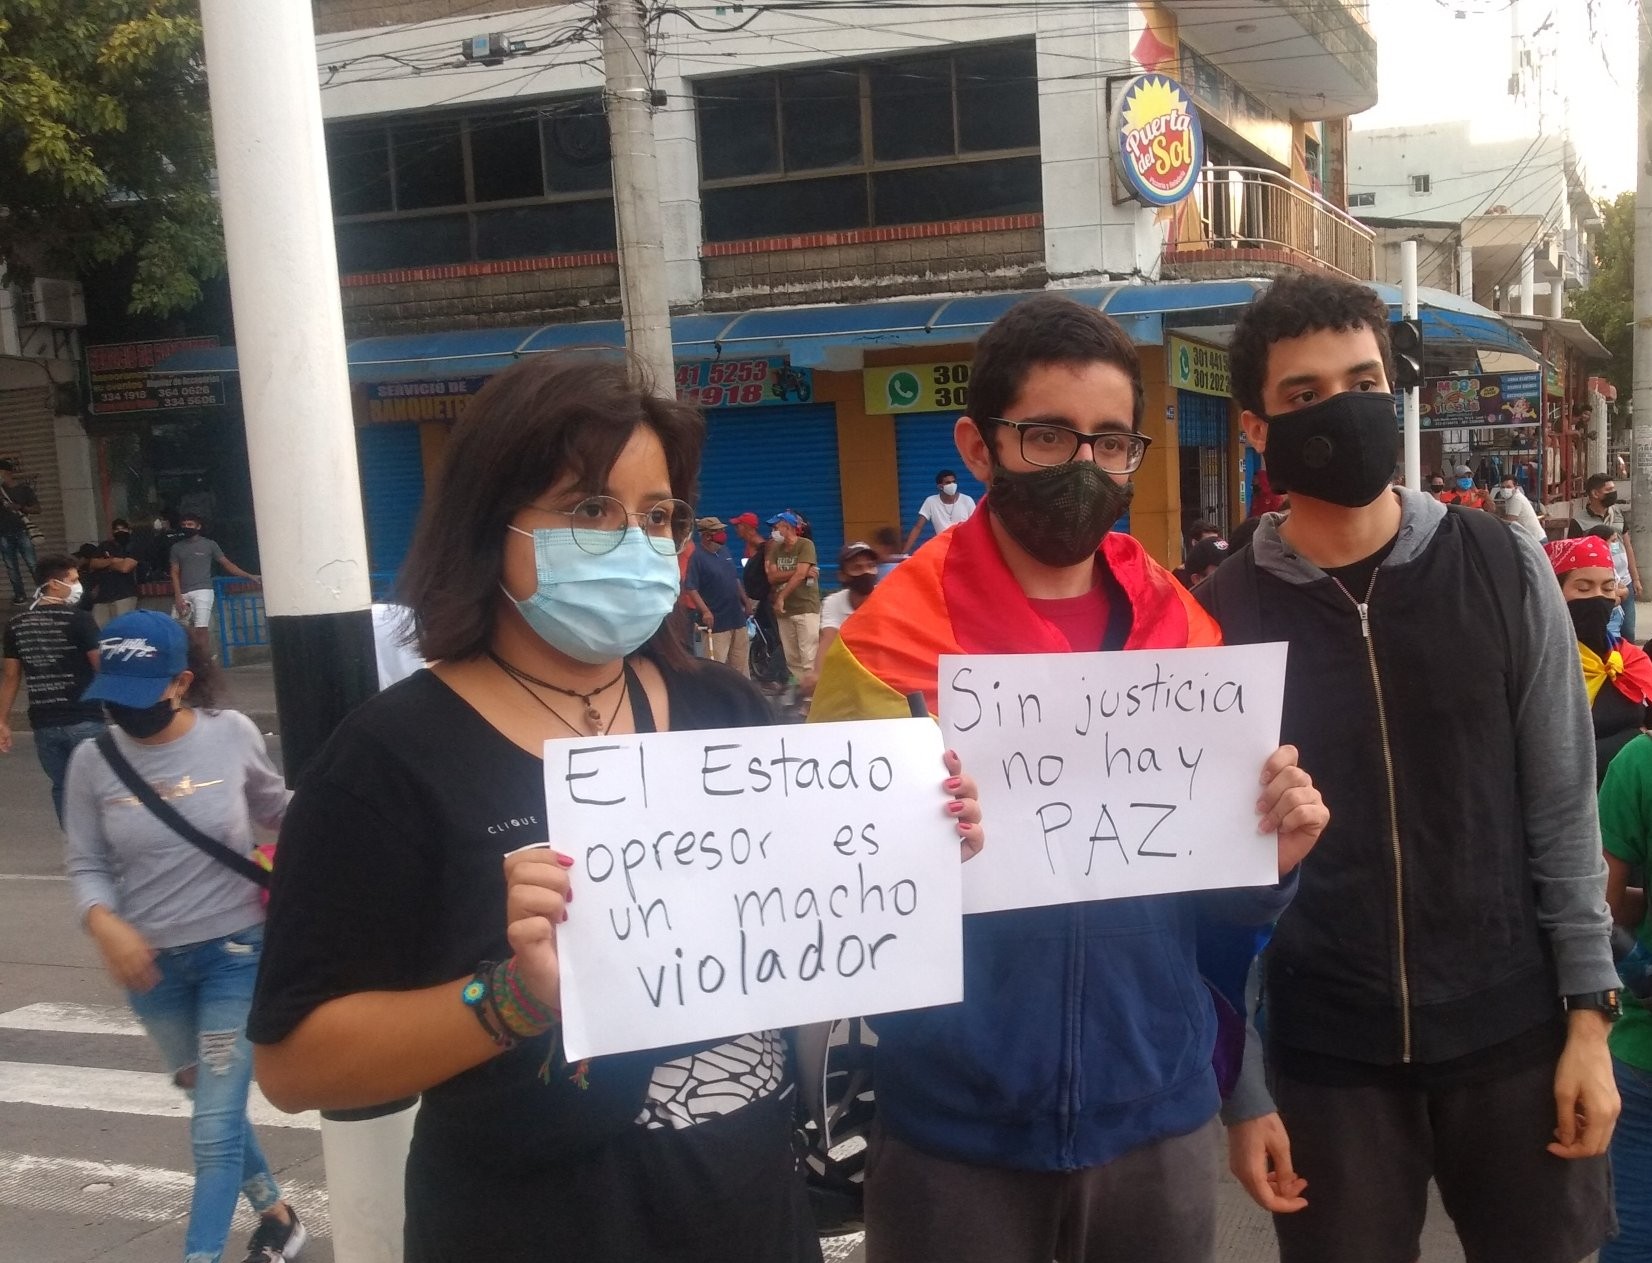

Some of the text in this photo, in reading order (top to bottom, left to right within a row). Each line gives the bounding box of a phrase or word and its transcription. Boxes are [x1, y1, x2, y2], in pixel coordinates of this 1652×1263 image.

[1126, 109, 1192, 157] Puerta
[1138, 130, 1191, 175] del Sol
[709, 360, 768, 385] 5253
[1192, 346, 1208, 368] 301
[1193, 368, 1209, 390] 301
[377, 381, 467, 397] SERVICIO DE
[952, 663, 1246, 736] Sin justicia
[565, 737, 894, 808] El Estado
[1002, 731, 1203, 801] no hay
[487, 815, 538, 834] CLIQUE
[1035, 801, 1193, 876] PAZ.
[586, 823, 880, 902] opresor es
[610, 863, 917, 940] un macho
[638, 920, 897, 1007] violador
